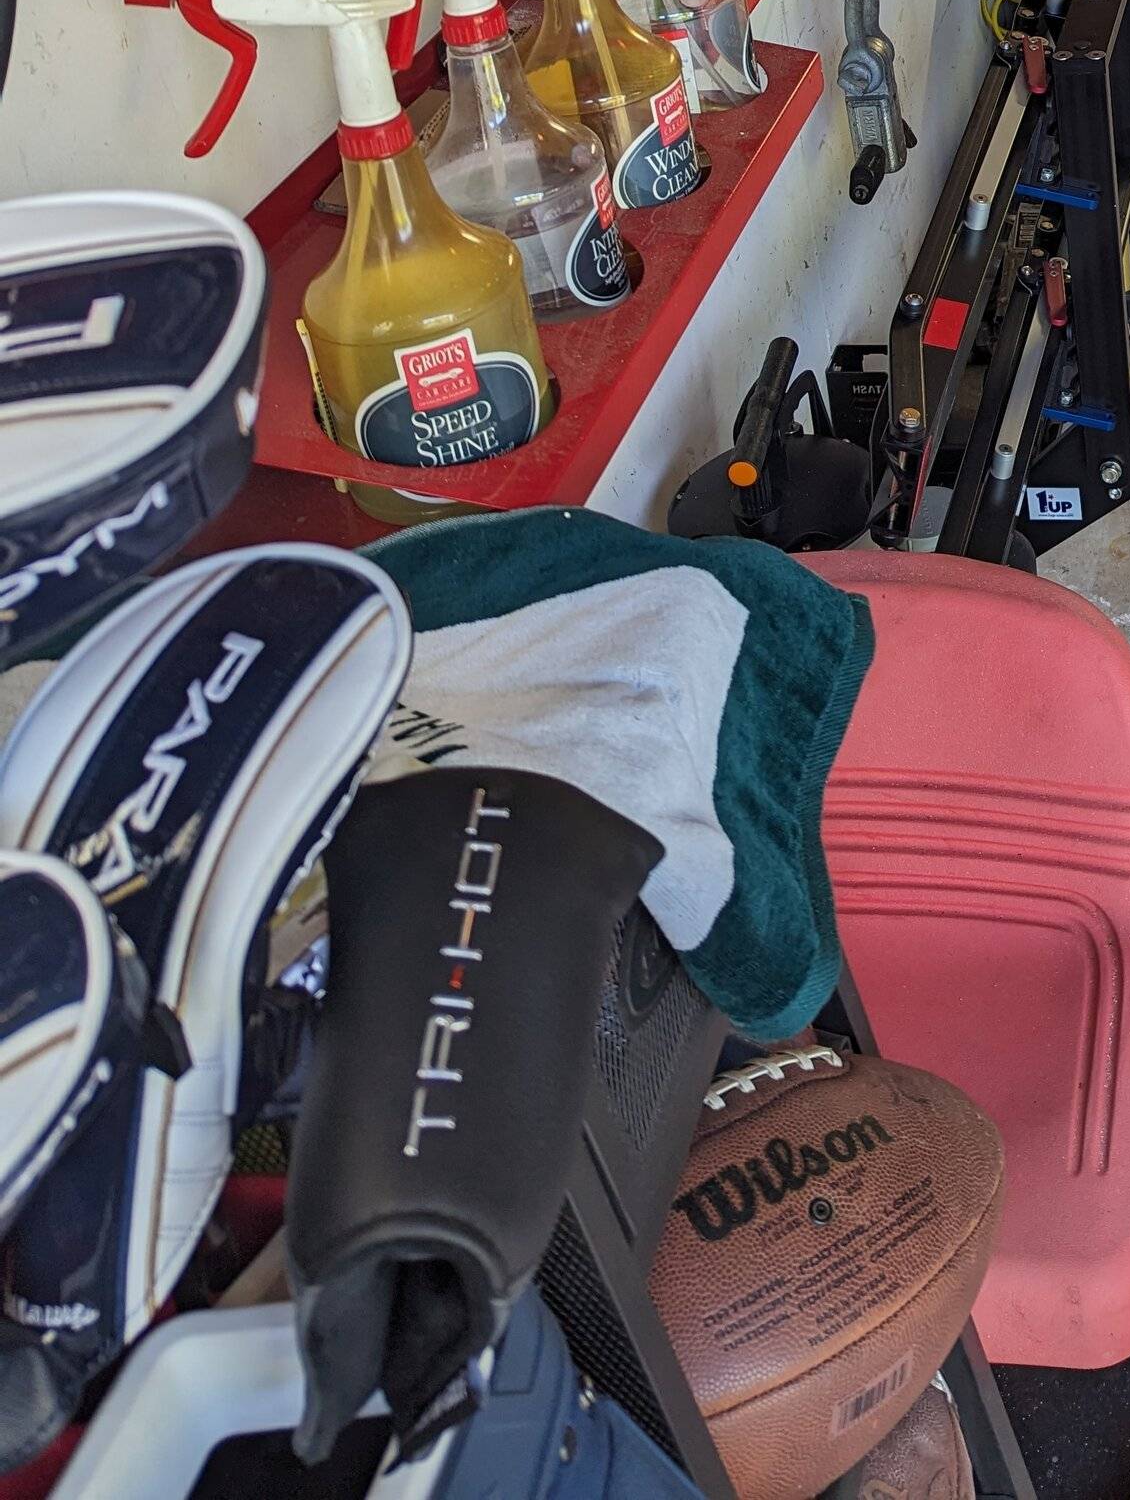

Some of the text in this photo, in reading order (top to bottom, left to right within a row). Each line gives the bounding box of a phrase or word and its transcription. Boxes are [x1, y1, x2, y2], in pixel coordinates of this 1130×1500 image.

[408, 342, 466, 377] GRIOT'S
[416, 386, 440, 400] CAR
[410, 400, 493, 442] SPEED
[415, 426, 500, 469] SHINE
[671, 1112, 898, 1243] Wilson
